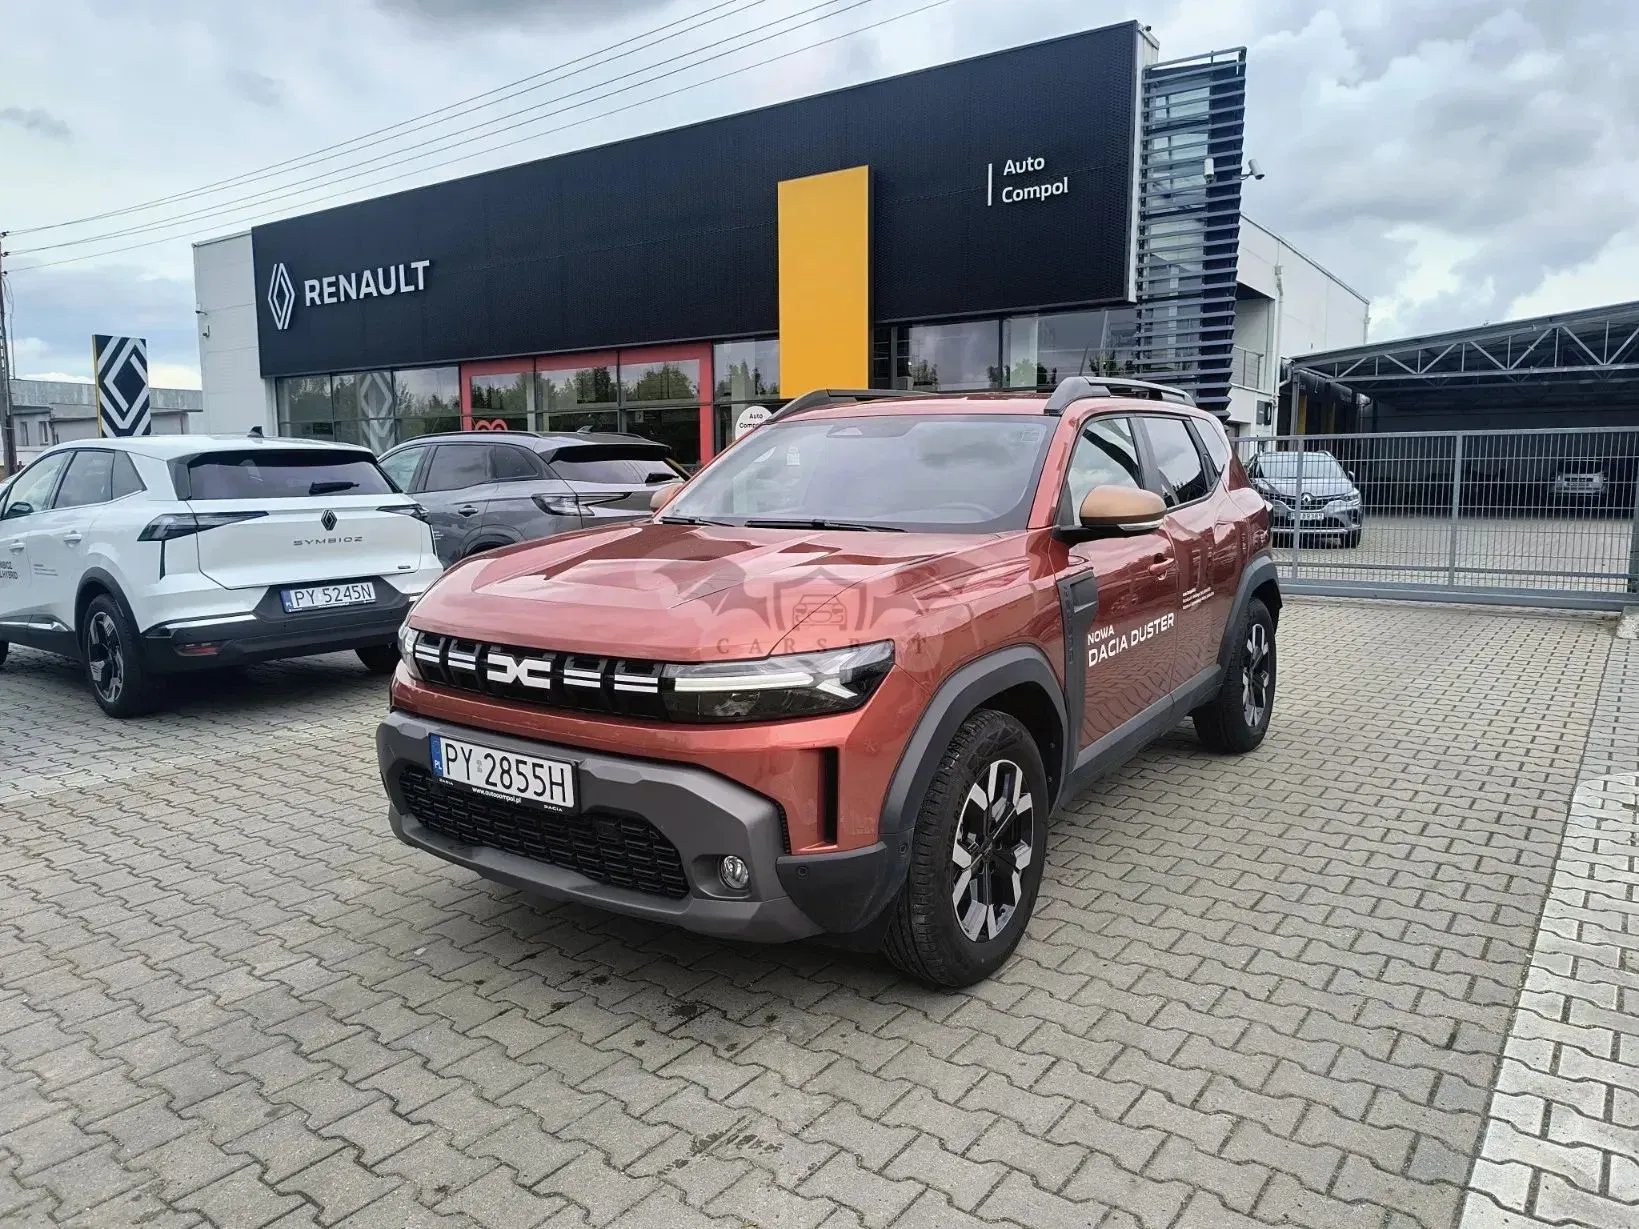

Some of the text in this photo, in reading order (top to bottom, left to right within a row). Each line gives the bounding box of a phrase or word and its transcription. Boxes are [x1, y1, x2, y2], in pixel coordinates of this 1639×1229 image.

[1003, 156, 1045, 176] Auto
[1001, 177, 1068, 203] Compol
[304, 259, 430, 307] RENAULT
[293, 536, 363, 546] SYMBIOZ
[294, 584, 372, 607] PY 5245N
[1087, 624, 1115, 646] NOWA
[1088, 612, 1175, 667] DACIA DUSTER
[433, 760, 443, 770] PL
[445, 743, 566, 803] PY 2855H
[472, 787, 522, 804] www.autocompol.pl
[543, 804, 563, 812] DACIA
